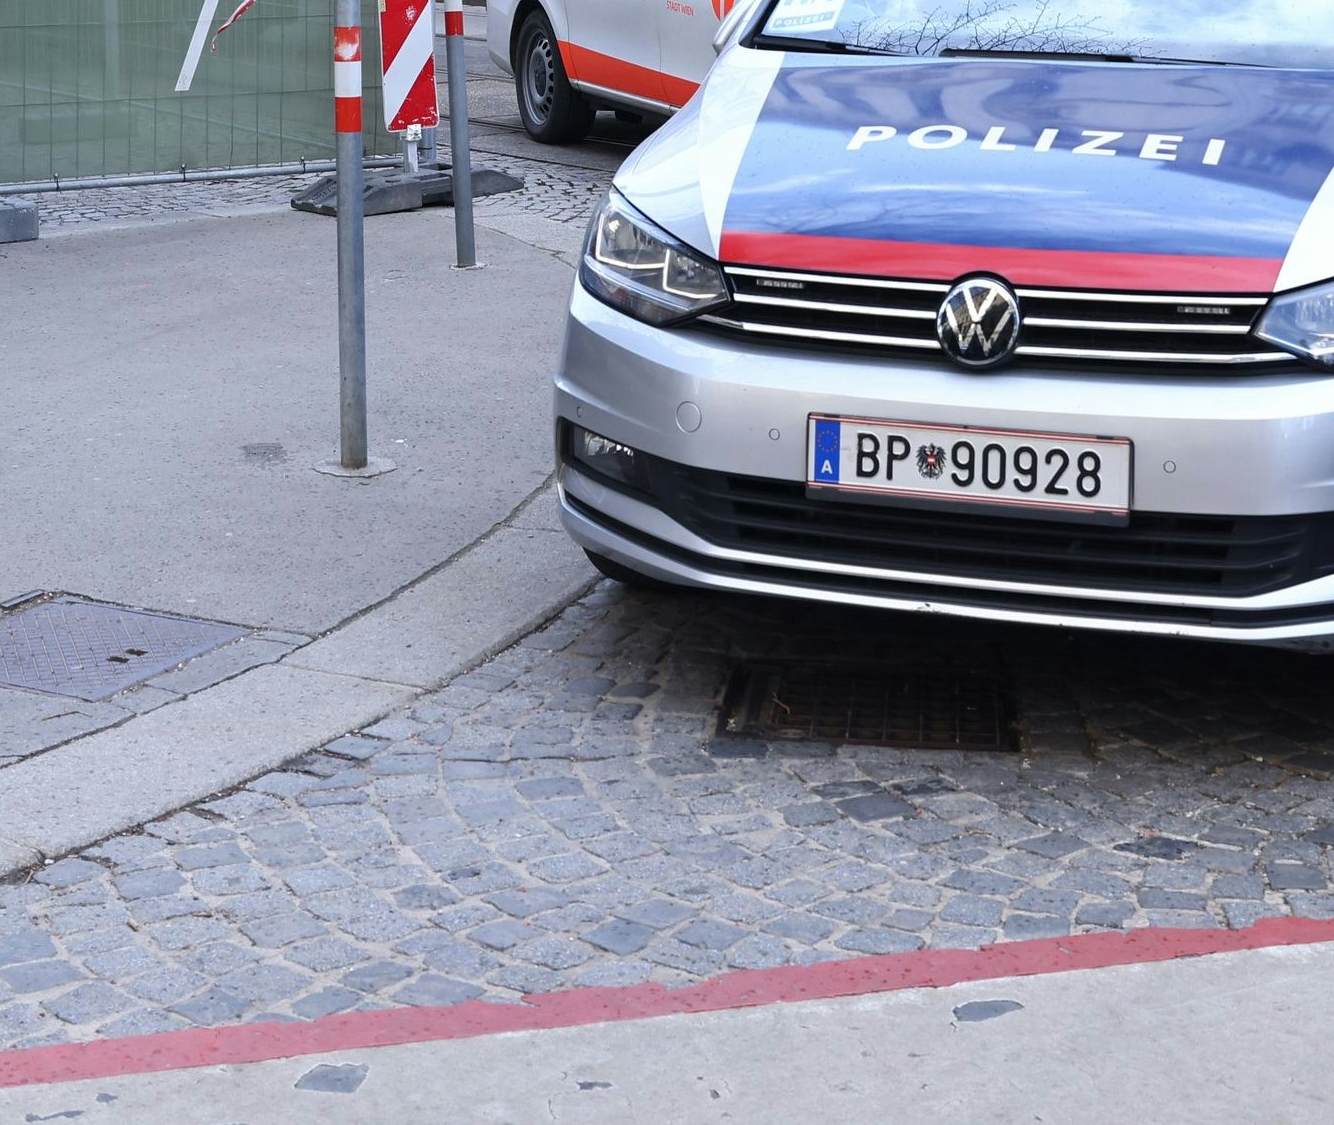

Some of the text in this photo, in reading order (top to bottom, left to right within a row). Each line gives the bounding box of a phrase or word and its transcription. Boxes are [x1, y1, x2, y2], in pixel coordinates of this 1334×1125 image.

[845, 125, 1226, 165] POLIZEI
[856, 432, 911, 481] BP
[950, 440, 1102, 497] 90928
